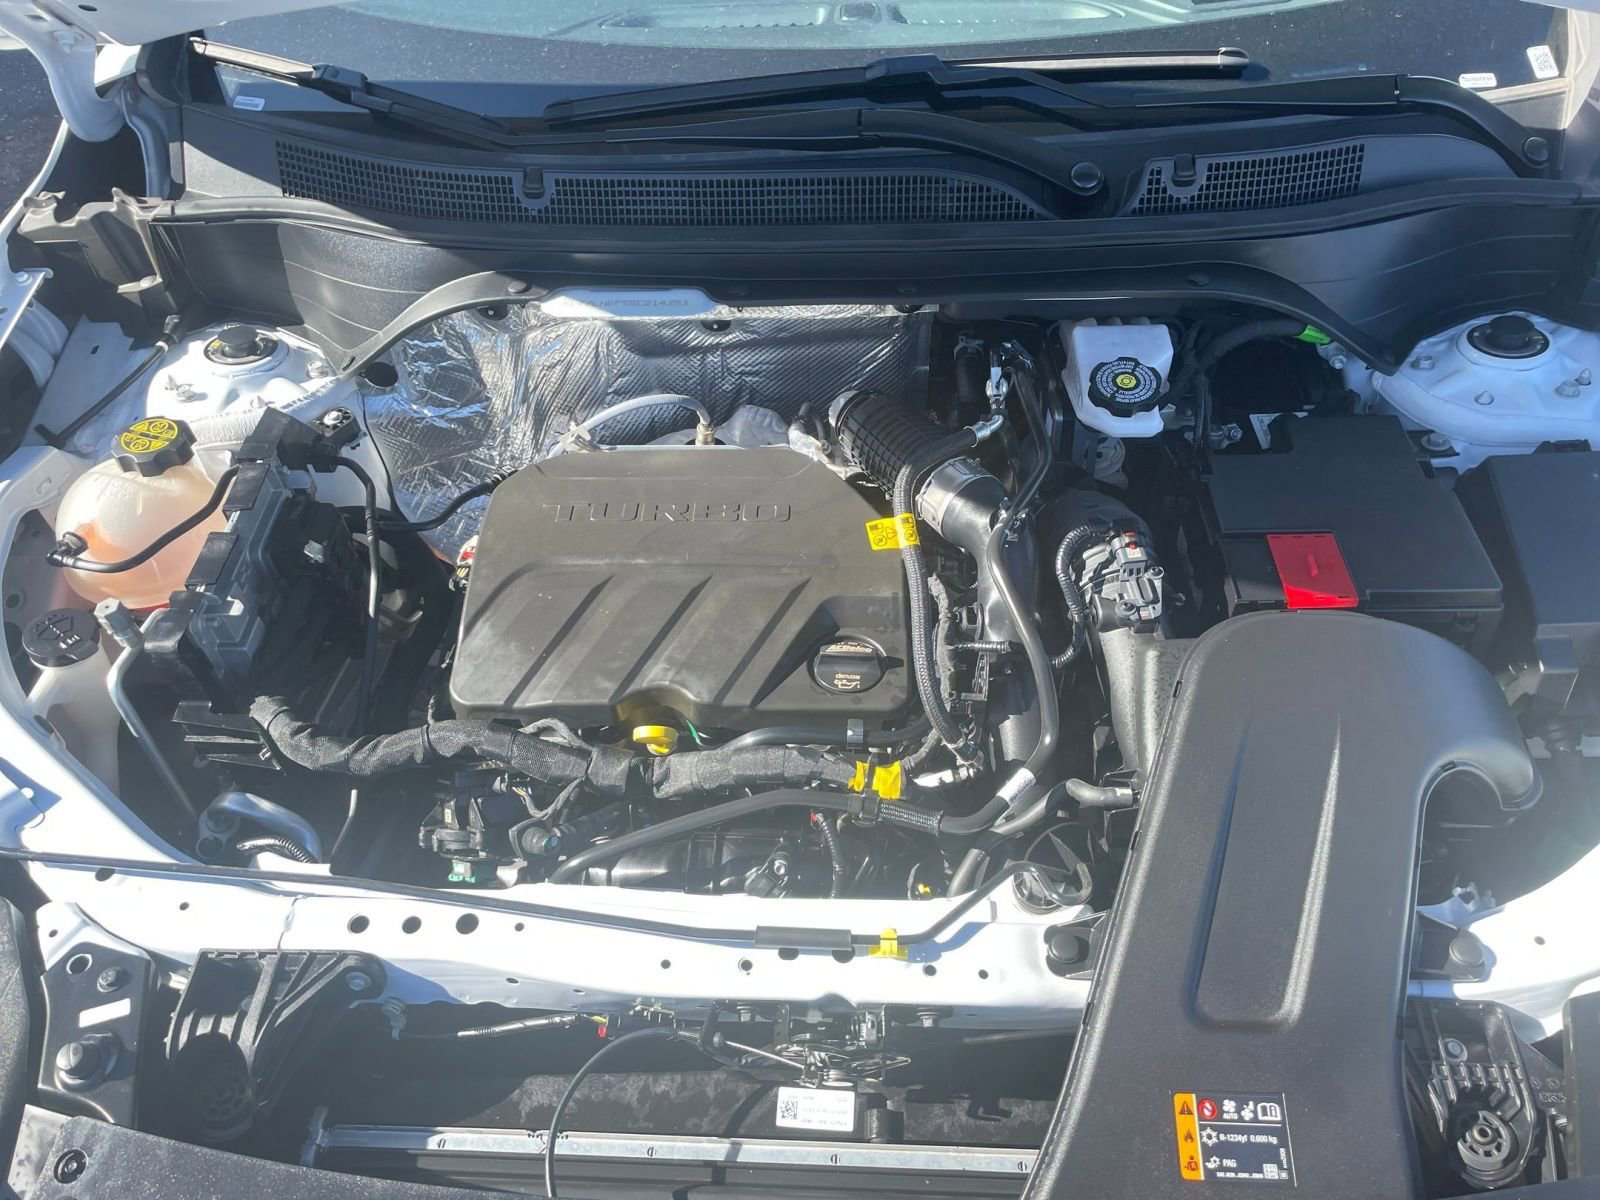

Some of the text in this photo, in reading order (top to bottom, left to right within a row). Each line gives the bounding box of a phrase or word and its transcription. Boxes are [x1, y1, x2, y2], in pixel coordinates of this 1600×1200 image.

[542, 502, 794, 523] TURBO
[1268, 1135, 1278, 1145] kg
[1222, 1158, 1237, 1168] PAG
